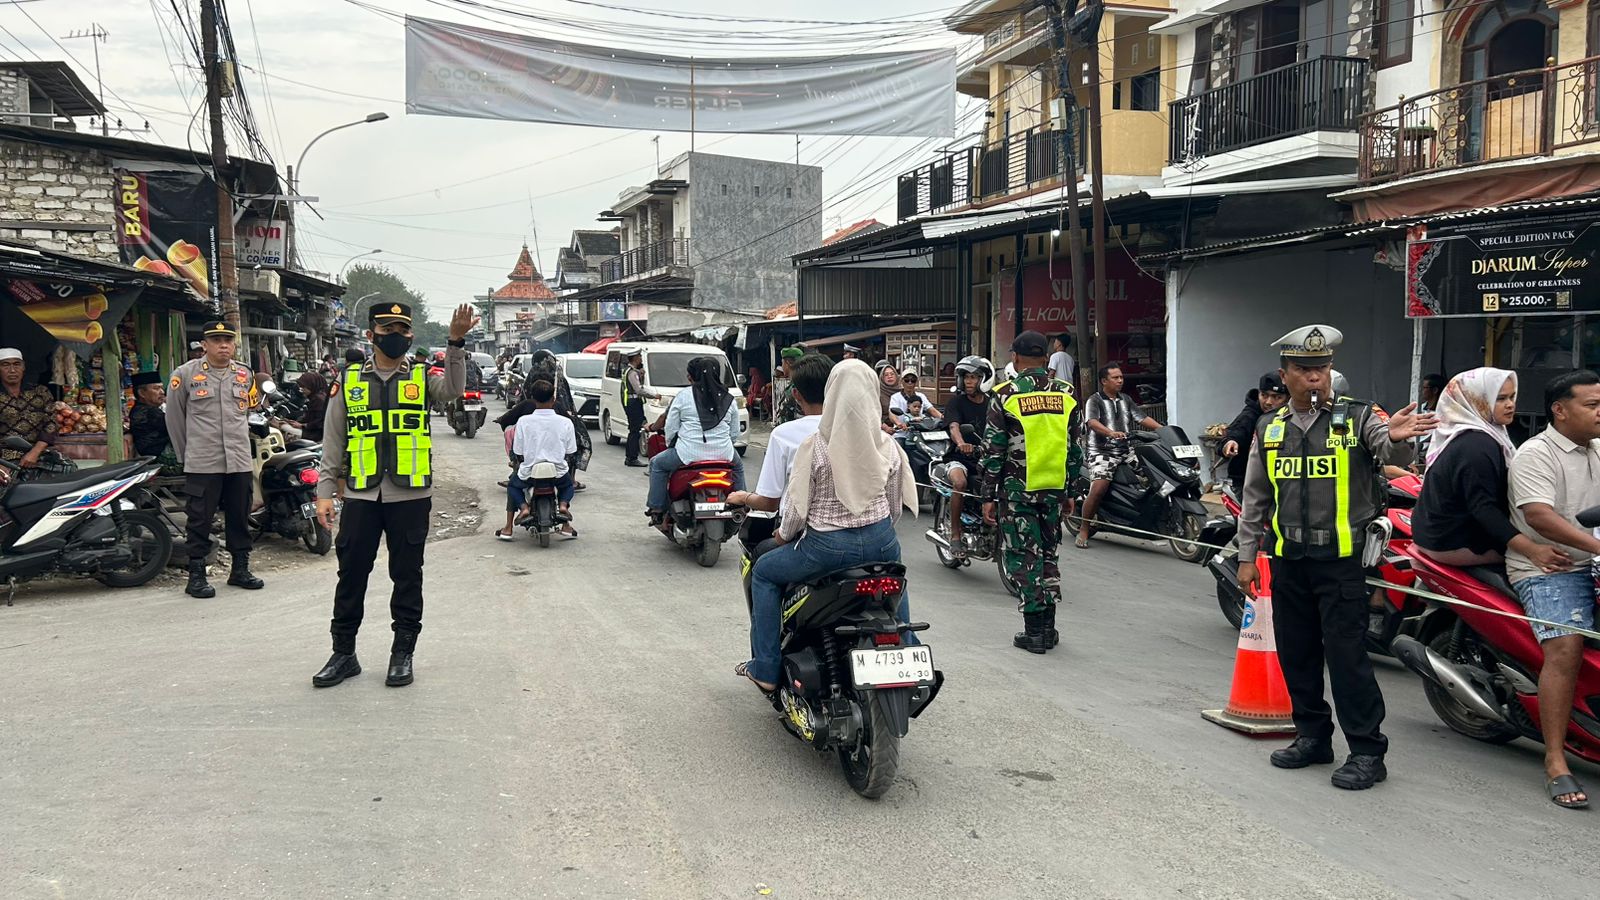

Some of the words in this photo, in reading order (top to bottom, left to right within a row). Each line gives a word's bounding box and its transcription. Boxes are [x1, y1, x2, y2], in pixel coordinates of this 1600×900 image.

[122, 176, 141, 236] BARU
[1480, 236, 1513, 246] SPECIAL
[1515, 233, 1551, 243] EDITION
[1552, 230, 1575, 240] PACK
[246, 255, 280, 265] COPIER
[1471, 256, 1537, 275] DJARUM
[1537, 248, 1589, 276] Super
[1477, 281, 1524, 290] CELEBRATION
[1526, 280, 1537, 288] OF
[1538, 279, 1581, 287] GREATNESS
[1486, 296, 1496, 306] 12
[1509, 295, 1552, 306] 25.000,-
[1020, 395, 1044, 407] KODIM
[856, 653, 866, 667] M
[875, 652, 904, 666] 4739
